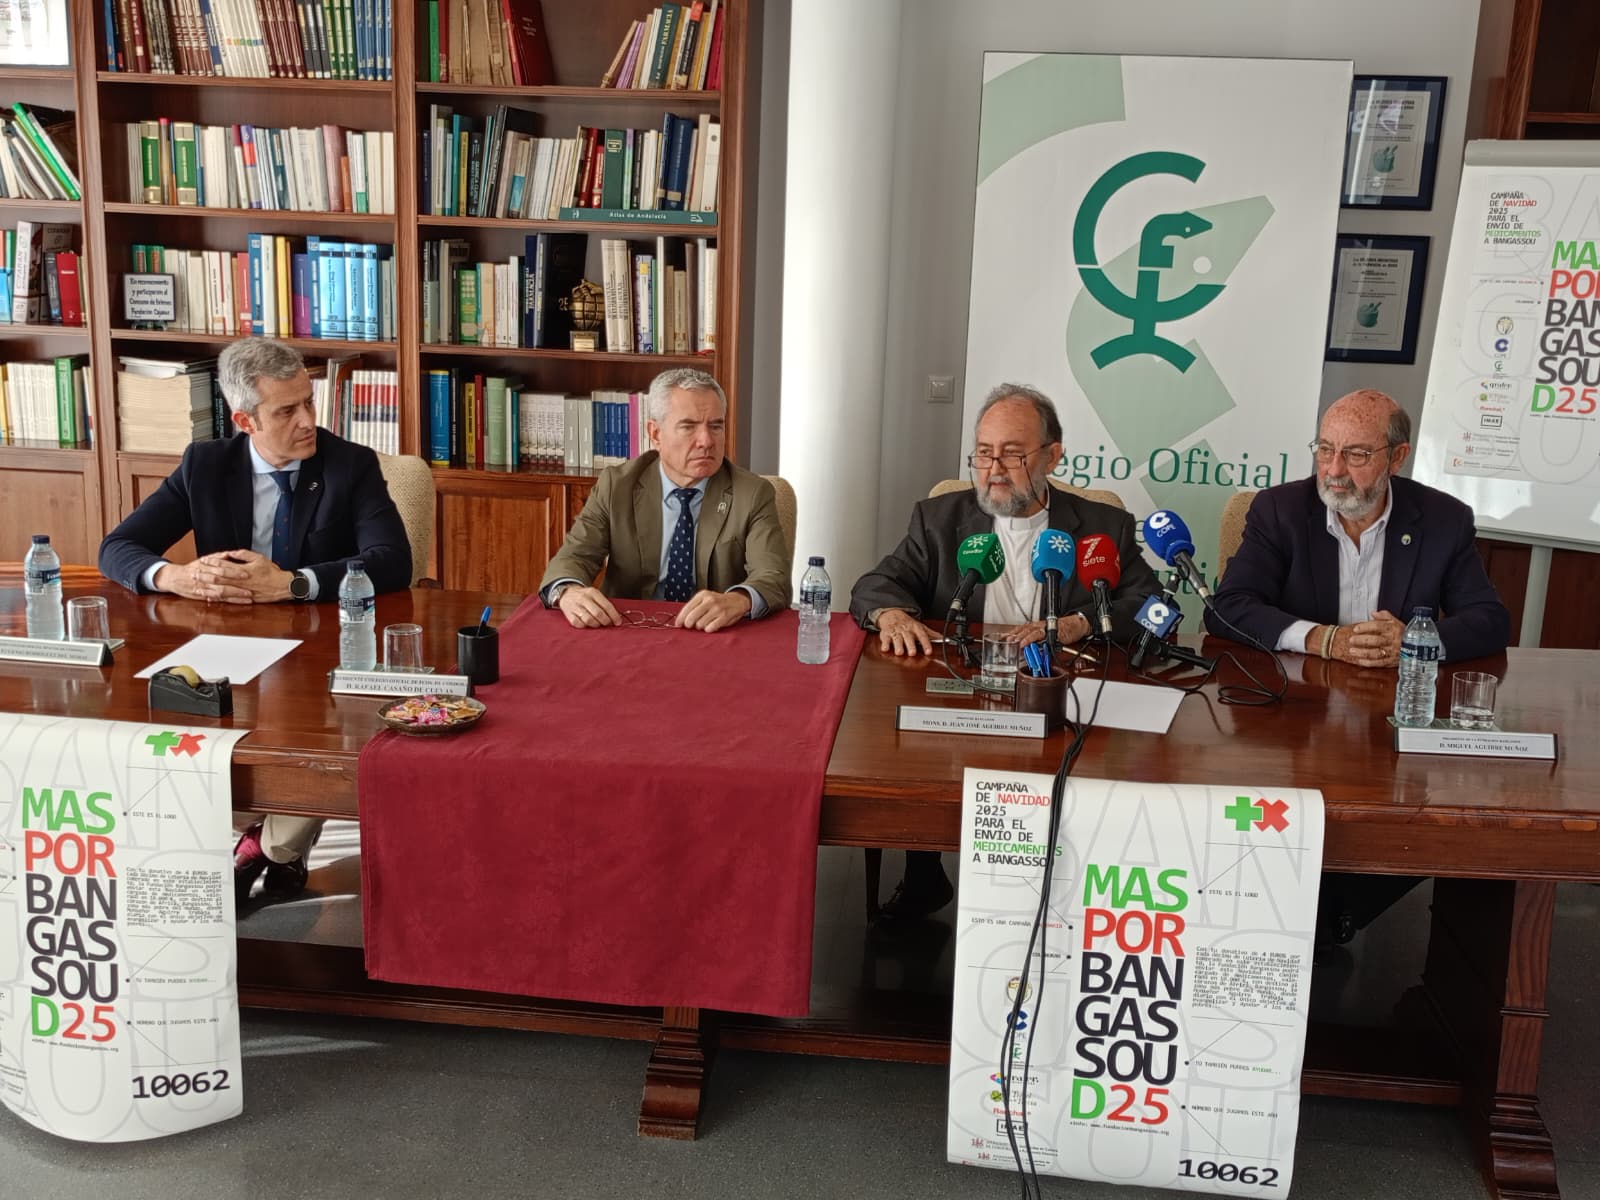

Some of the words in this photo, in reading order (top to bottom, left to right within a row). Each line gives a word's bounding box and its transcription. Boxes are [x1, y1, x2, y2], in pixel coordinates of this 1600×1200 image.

[1490, 191, 1524, 200] CAMPAÑA
[1552, 240, 1600, 270] MA
[1549, 270, 1600, 299] PO
[1540, 328, 1600, 358] GAS
[1536, 356, 1600, 387] SOU
[1531, 384, 1598, 414] D25
[1051, 445, 1132, 489] egio
[1149, 448, 1288, 488] Oficial
[976, 781, 1028, 792] CAMPAÑA
[976, 792, 991, 803] DE
[997, 793, 1050, 806] NAVIDAD
[22, 787, 116, 835] MAS
[974, 817, 1004, 828] PARA
[1012, 819, 1026, 830] EL
[976, 805, 1006, 816] 2025
[973, 840, 1063, 856] MEDICAMENTS
[1018, 832, 1033, 842] DE
[24, 830, 118, 878] POR
[973, 853, 981, 863] A
[988, 854, 1048, 867] BANGASSO
[26, 873, 117, 921] BAN
[1083, 864, 1189, 913] MAS
[26, 916, 117, 962] GAS
[1083, 908, 1186, 957] POR
[31, 955, 118, 1003] SOU
[1080, 952, 1185, 1000] BAN
[31, 996, 116, 1042] D25
[1076, 995, 1179, 1042] GAS
[1073, 1037, 1178, 1085] SOU
[132, 1069, 231, 1100] 10062
[1070, 1078, 1170, 1125] D25
[1178, 1159, 1279, 1187] 10062
